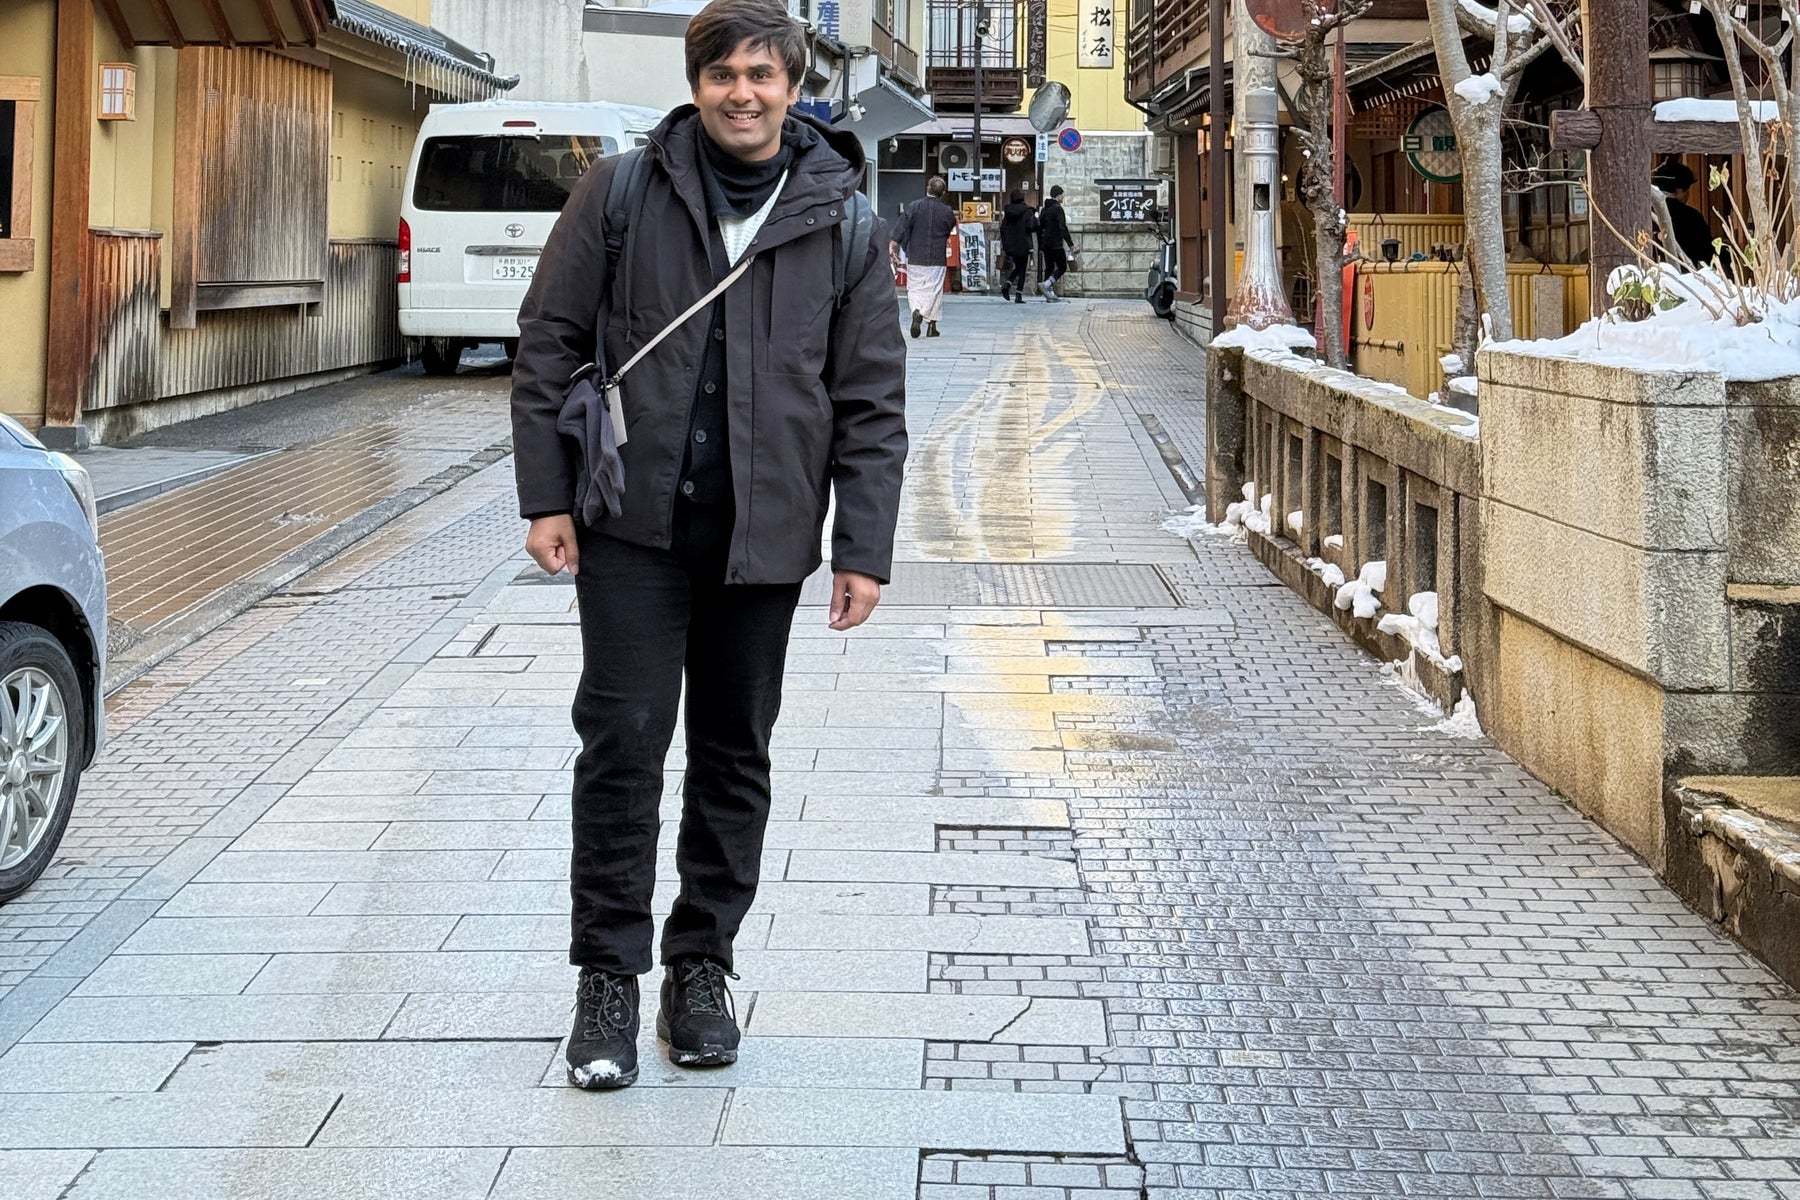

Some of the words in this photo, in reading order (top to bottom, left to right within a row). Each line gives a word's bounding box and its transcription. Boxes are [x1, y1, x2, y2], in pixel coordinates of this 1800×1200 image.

[1090, 6, 1111, 58] 松屋
[1103, 197, 1153, 211] つばたや
